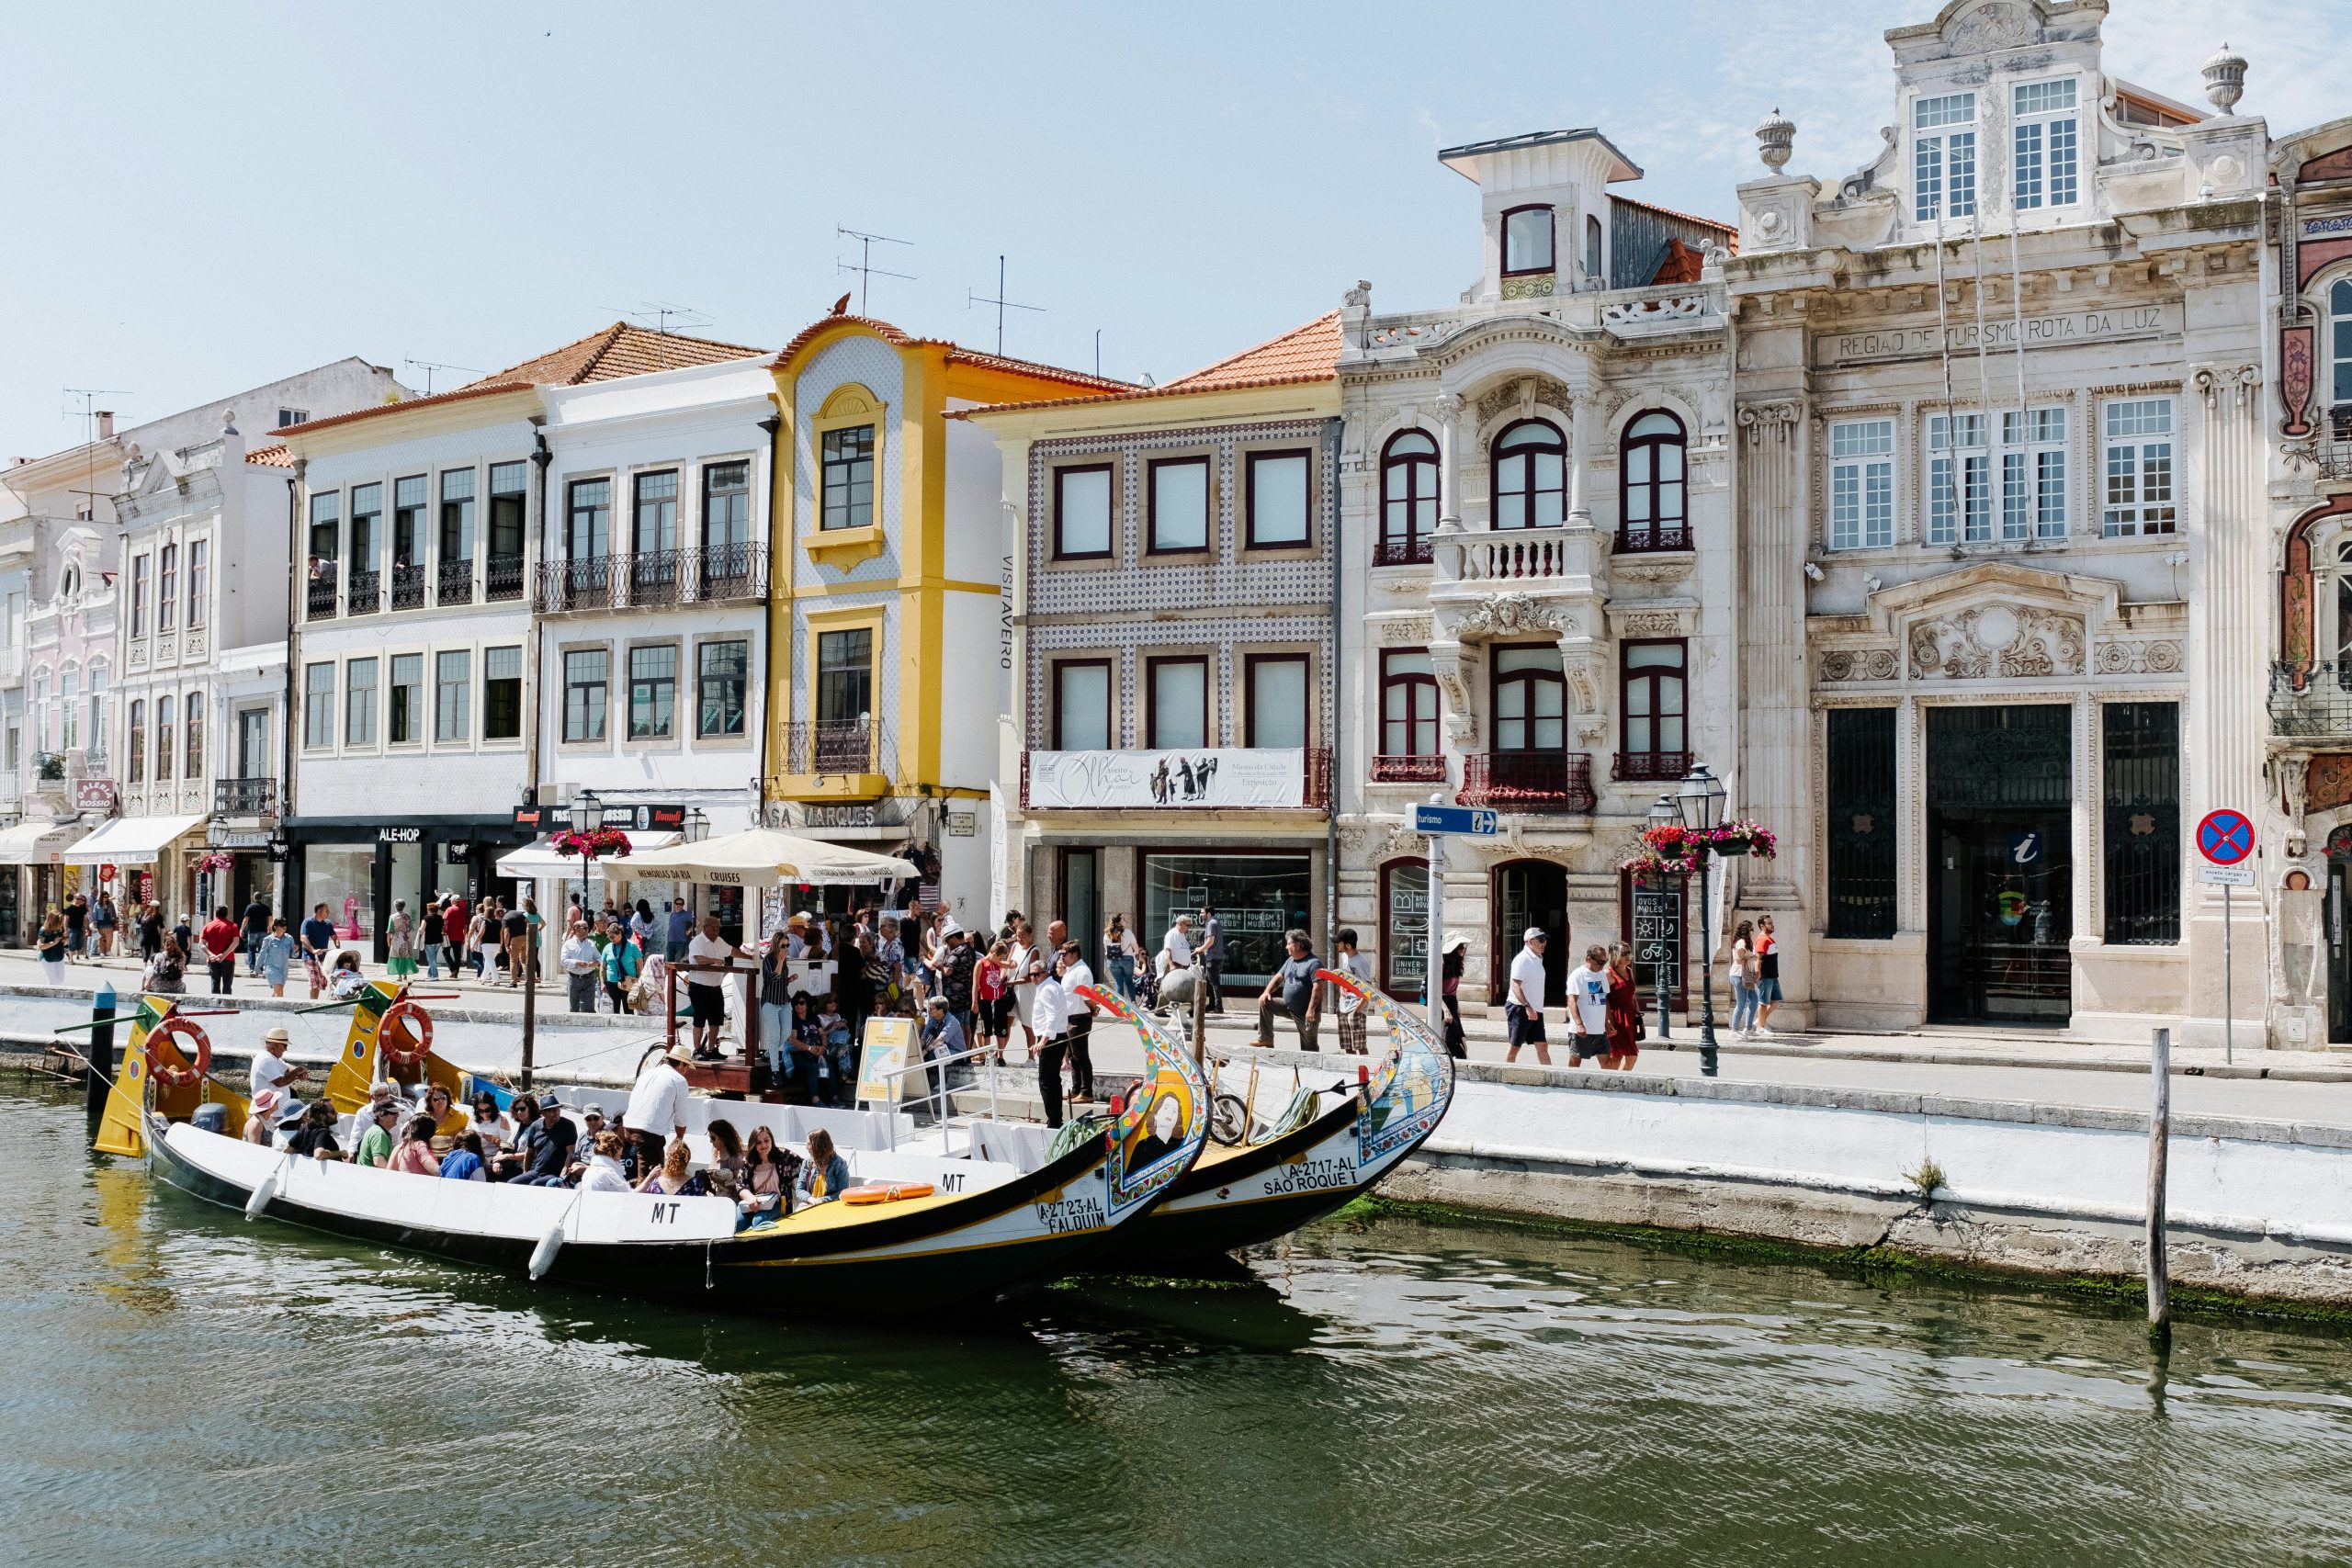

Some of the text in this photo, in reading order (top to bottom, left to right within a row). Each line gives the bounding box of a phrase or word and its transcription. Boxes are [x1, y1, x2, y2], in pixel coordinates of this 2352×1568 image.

[1911, 330, 1935, 350] DE
[2029, 318, 2075, 340] ROTA
[2086, 313, 2111, 334] DA
[2120, 308, 2161, 331] LUZ
[1242, 778, 1277, 787] Exposição
[78, 782, 113, 799] GALERIA
[751, 806, 876, 828] CASA MARQUES
[1418, 814, 1442, 824] turismo
[379, 828, 421, 841] ALE-HOP
[671, 870, 680, 879] DA
[680, 870, 691, 879] RIA
[710, 872, 741, 883] CRUISES
[1638, 897, 1657, 906] OVOS
[1638, 905, 1663, 913] MOLES
[1396, 960, 1424, 968] UNIVER-
[1396, 967, 1421, 976] SIDADE
[1289, 1156, 1357, 1179] A-2717-AL
[943, 1173, 966, 1192] MT
[1263, 1170, 1359, 1195] SÃO ROQUE I
[650, 1202, 681, 1224] MT
